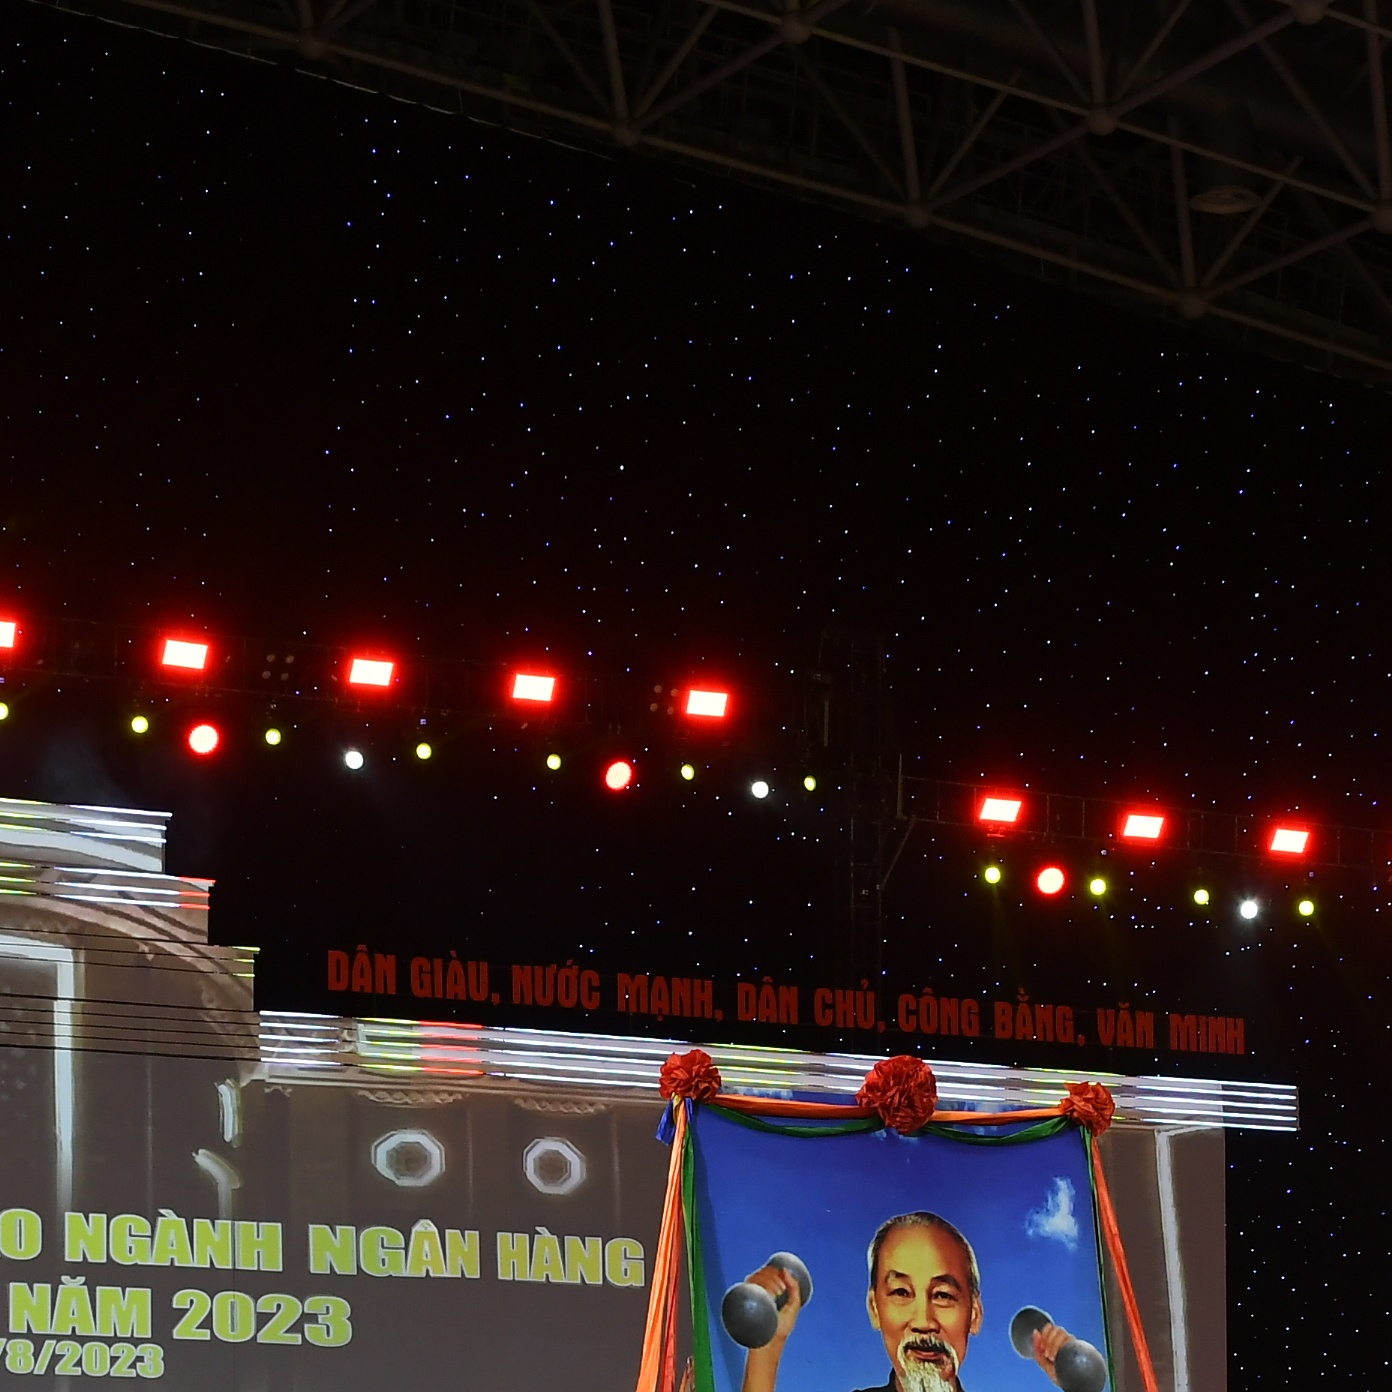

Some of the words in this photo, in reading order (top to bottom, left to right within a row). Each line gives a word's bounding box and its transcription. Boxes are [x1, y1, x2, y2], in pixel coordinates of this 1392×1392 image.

[327, 944, 396, 996] DÂN
[411, 950, 500, 1006] GIÀU,
[511, 960, 601, 1010] NƯỚC
[617, 972, 723, 1023] MẠNH,
[737, 976, 798, 1025] DÂN
[814, 978, 885, 1034] CHỦ,
[897, 987, 979, 1038] CÔNG
[994, 988, 1086, 1047] BẰNG,
[1097, 1002, 1154, 1049] VĂN
[1169, 1012, 1245, 1055] MINH
[64, 1207, 283, 1272] NGÀNH
[309, 1219, 481, 1278] NGÂN
[496, 1226, 645, 1287] HÀNG
[8, 1274, 152, 1337] NĂM
[171, 1288, 353, 1347] 2023
